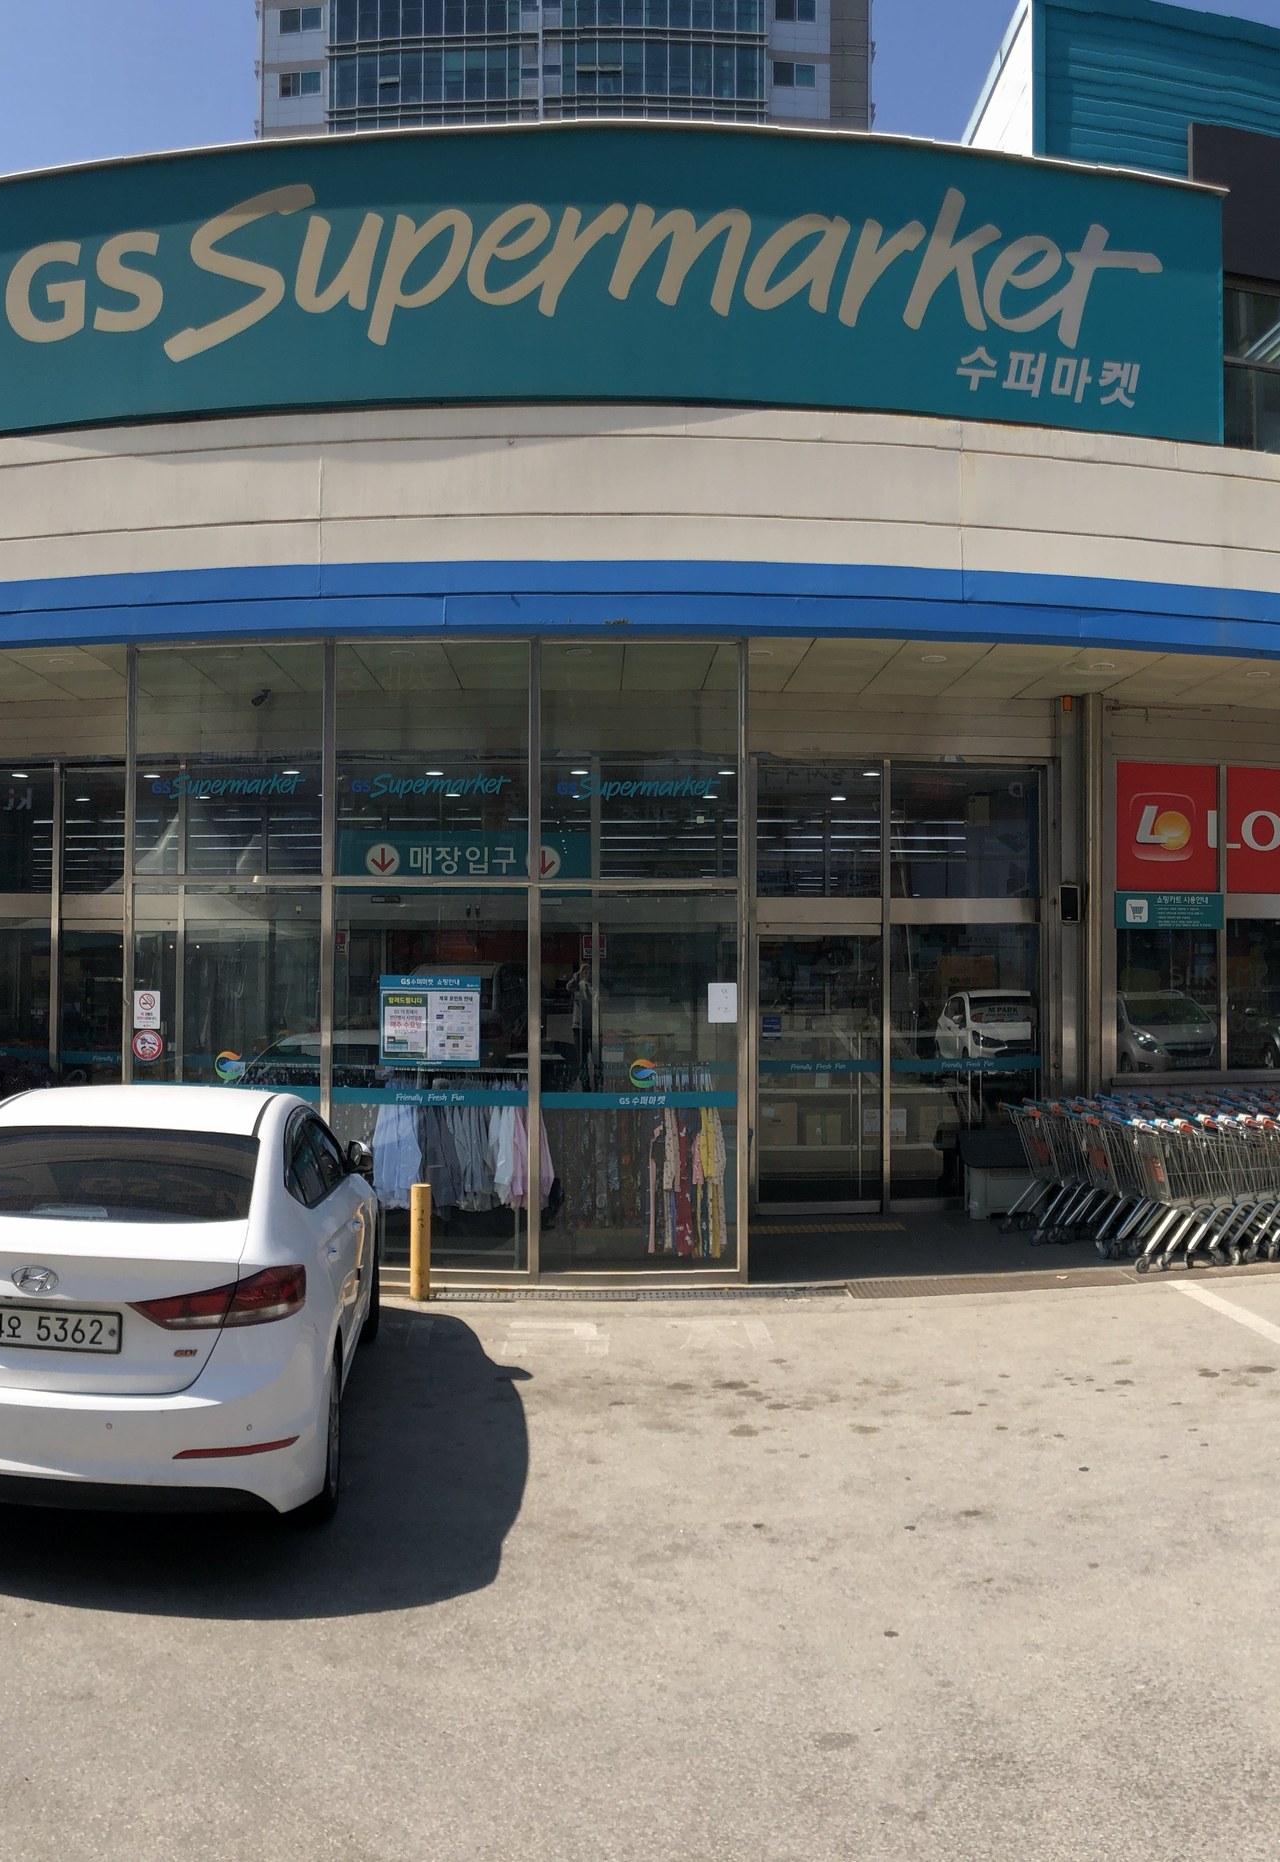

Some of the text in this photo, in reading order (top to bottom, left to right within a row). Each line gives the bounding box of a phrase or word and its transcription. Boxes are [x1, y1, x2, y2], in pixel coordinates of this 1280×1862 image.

[5, 184, 1163, 364] GS Supermarket
[954, 347, 1140, 409] 수퍼마켓
[151, 773, 307, 800] GS Supermarket
[351, 773, 511, 799] GS Supermarket
[556, 774, 720, 801] GS Supermarket
[409, 845, 517, 875] 매장입구
[1156, 896, 1209, 904] 쇼핑카트 사용안내
[400, 978, 434, 986] GS수퍼마켓
[988, 1006, 1018, 1014] M PARK
[404, 1021, 422, 1029] 수요일
[790, 1063, 813, 1072] Friendly
[816, 1063, 832, 1071] Fresh
[941, 1060, 995, 1070] Friendly Fresh Fun
[395, 1093, 465, 1103] Friendly Fresh Fun
[619, 1095, 667, 1106] GS수퍼마켓
[36, 1314, 104, 1345] 5362
